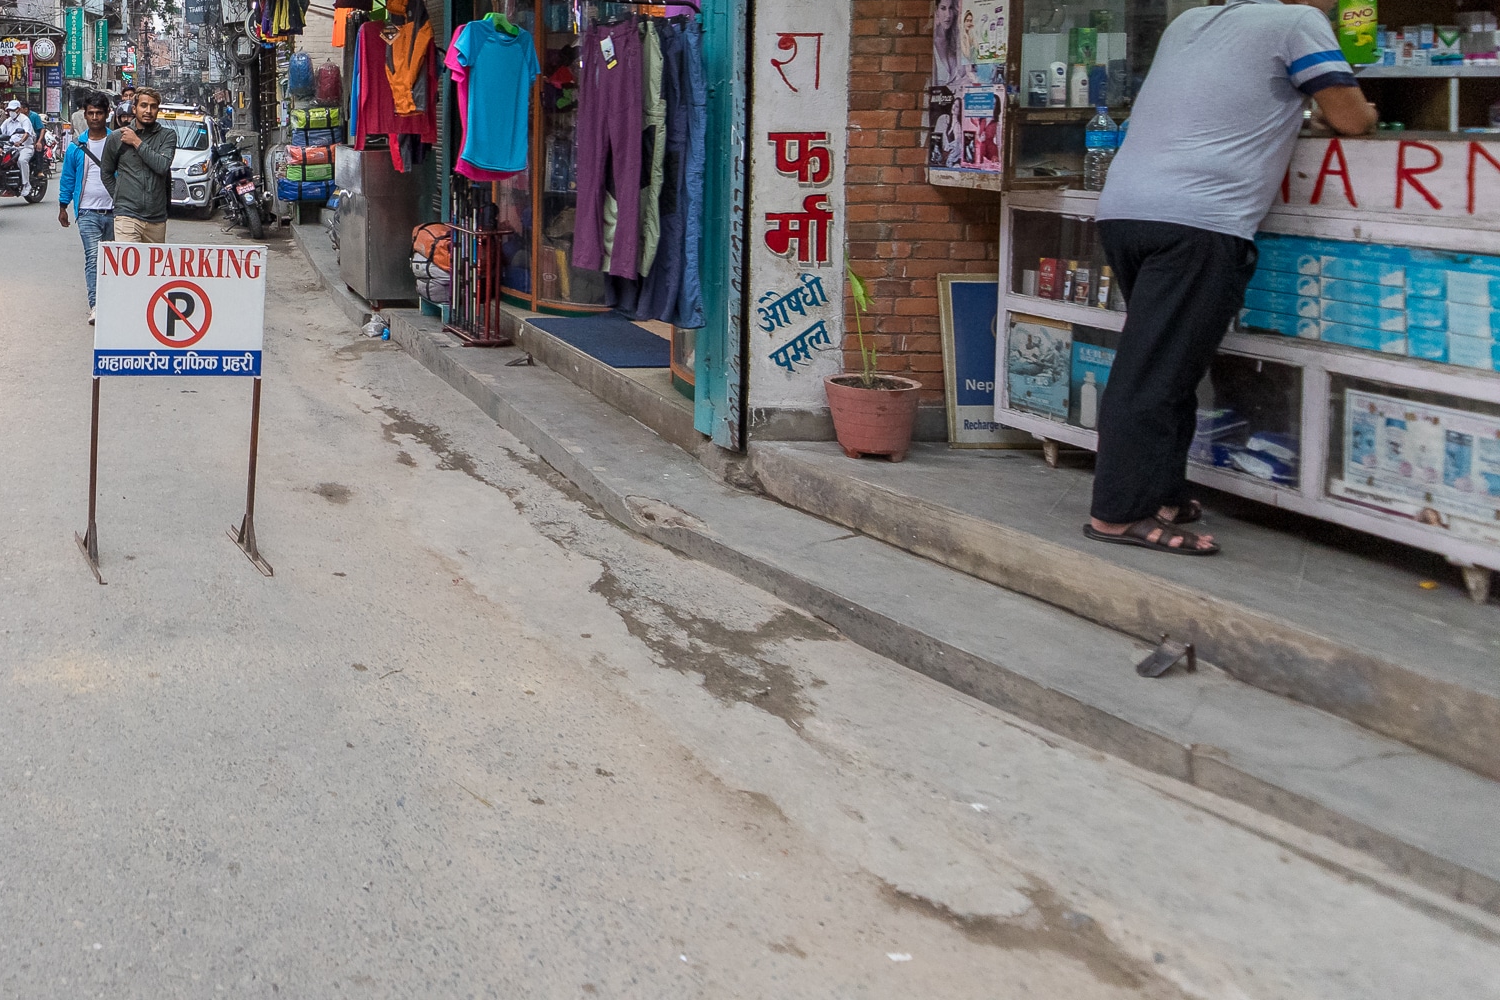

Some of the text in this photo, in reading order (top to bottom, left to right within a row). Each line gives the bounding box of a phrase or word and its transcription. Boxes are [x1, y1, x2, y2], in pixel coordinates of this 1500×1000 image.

[1342, 8, 1374, 21] ENO
[101, 245, 262, 280] NO PARKING
[166, 291, 195, 337] P
[97, 350, 255, 375] महानगरीय ट्राफिक प्रहरी
[965, 379, 994, 393] Nep
[963, 419, 999, 432] Recharge
